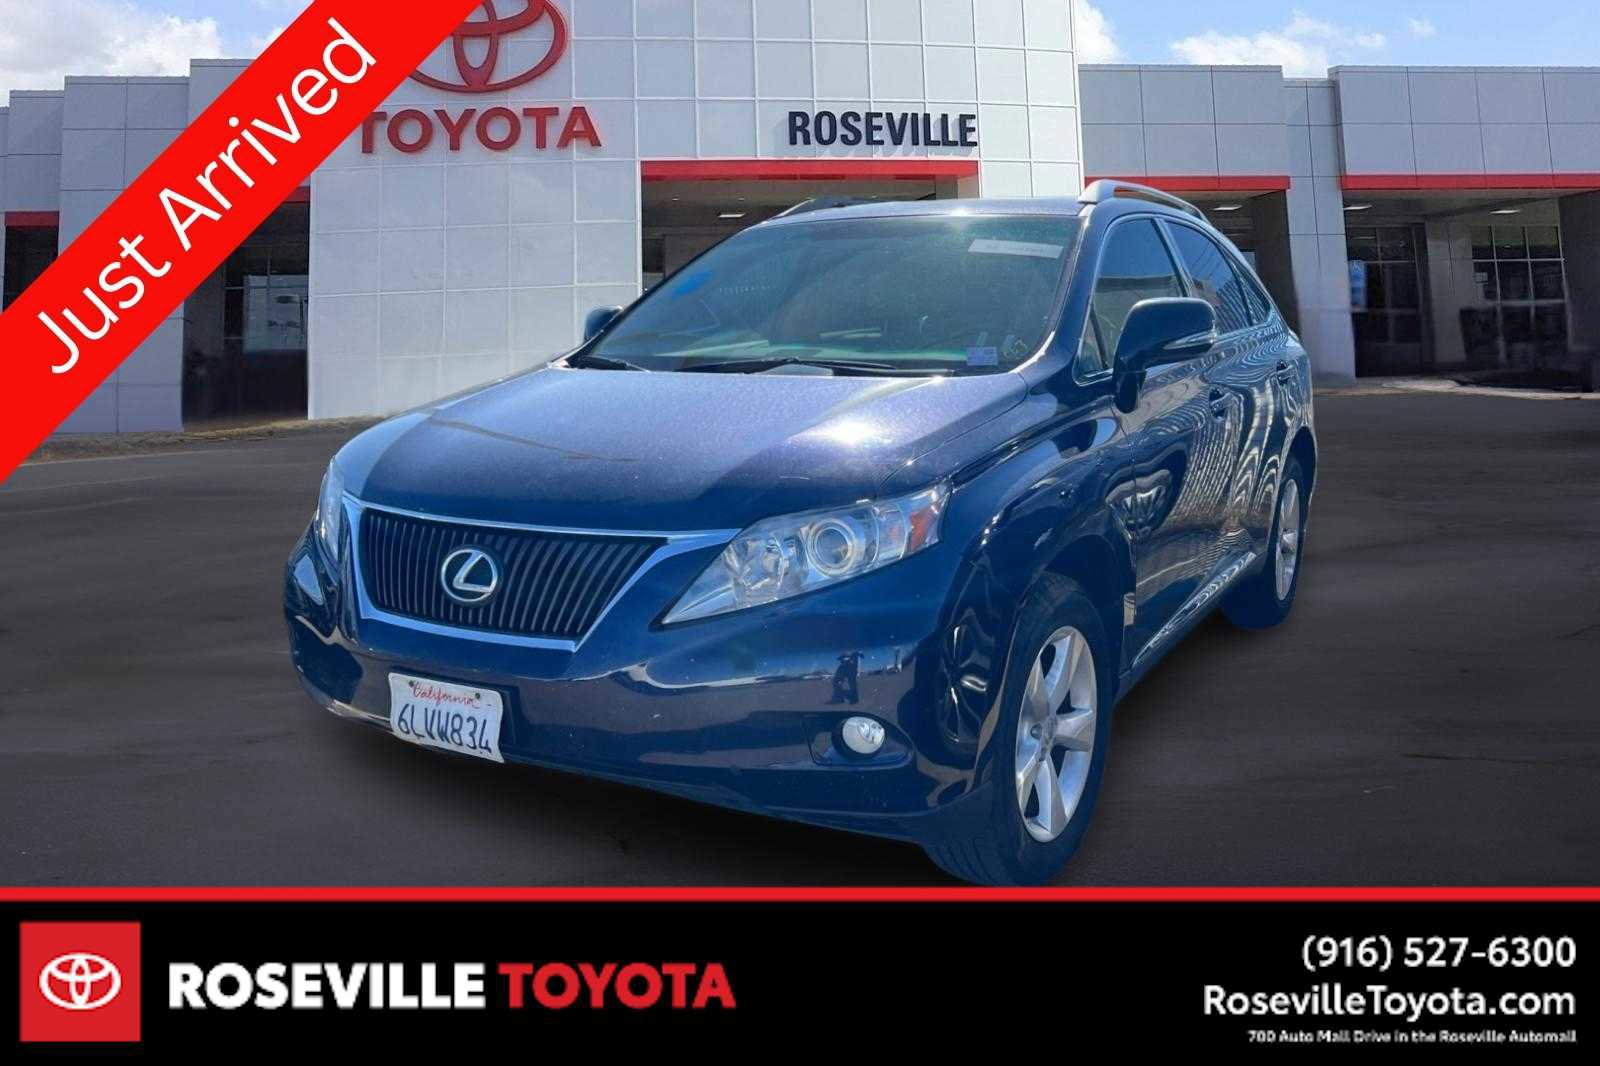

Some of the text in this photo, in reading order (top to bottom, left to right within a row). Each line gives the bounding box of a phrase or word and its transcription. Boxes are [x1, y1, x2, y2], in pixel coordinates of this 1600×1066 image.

[361, 106, 602, 153] TOYOTA
[788, 110, 978, 147] ROSEVILLE
[412, 681, 481, 709] California
[397, 703, 492, 753] 6LVW834
